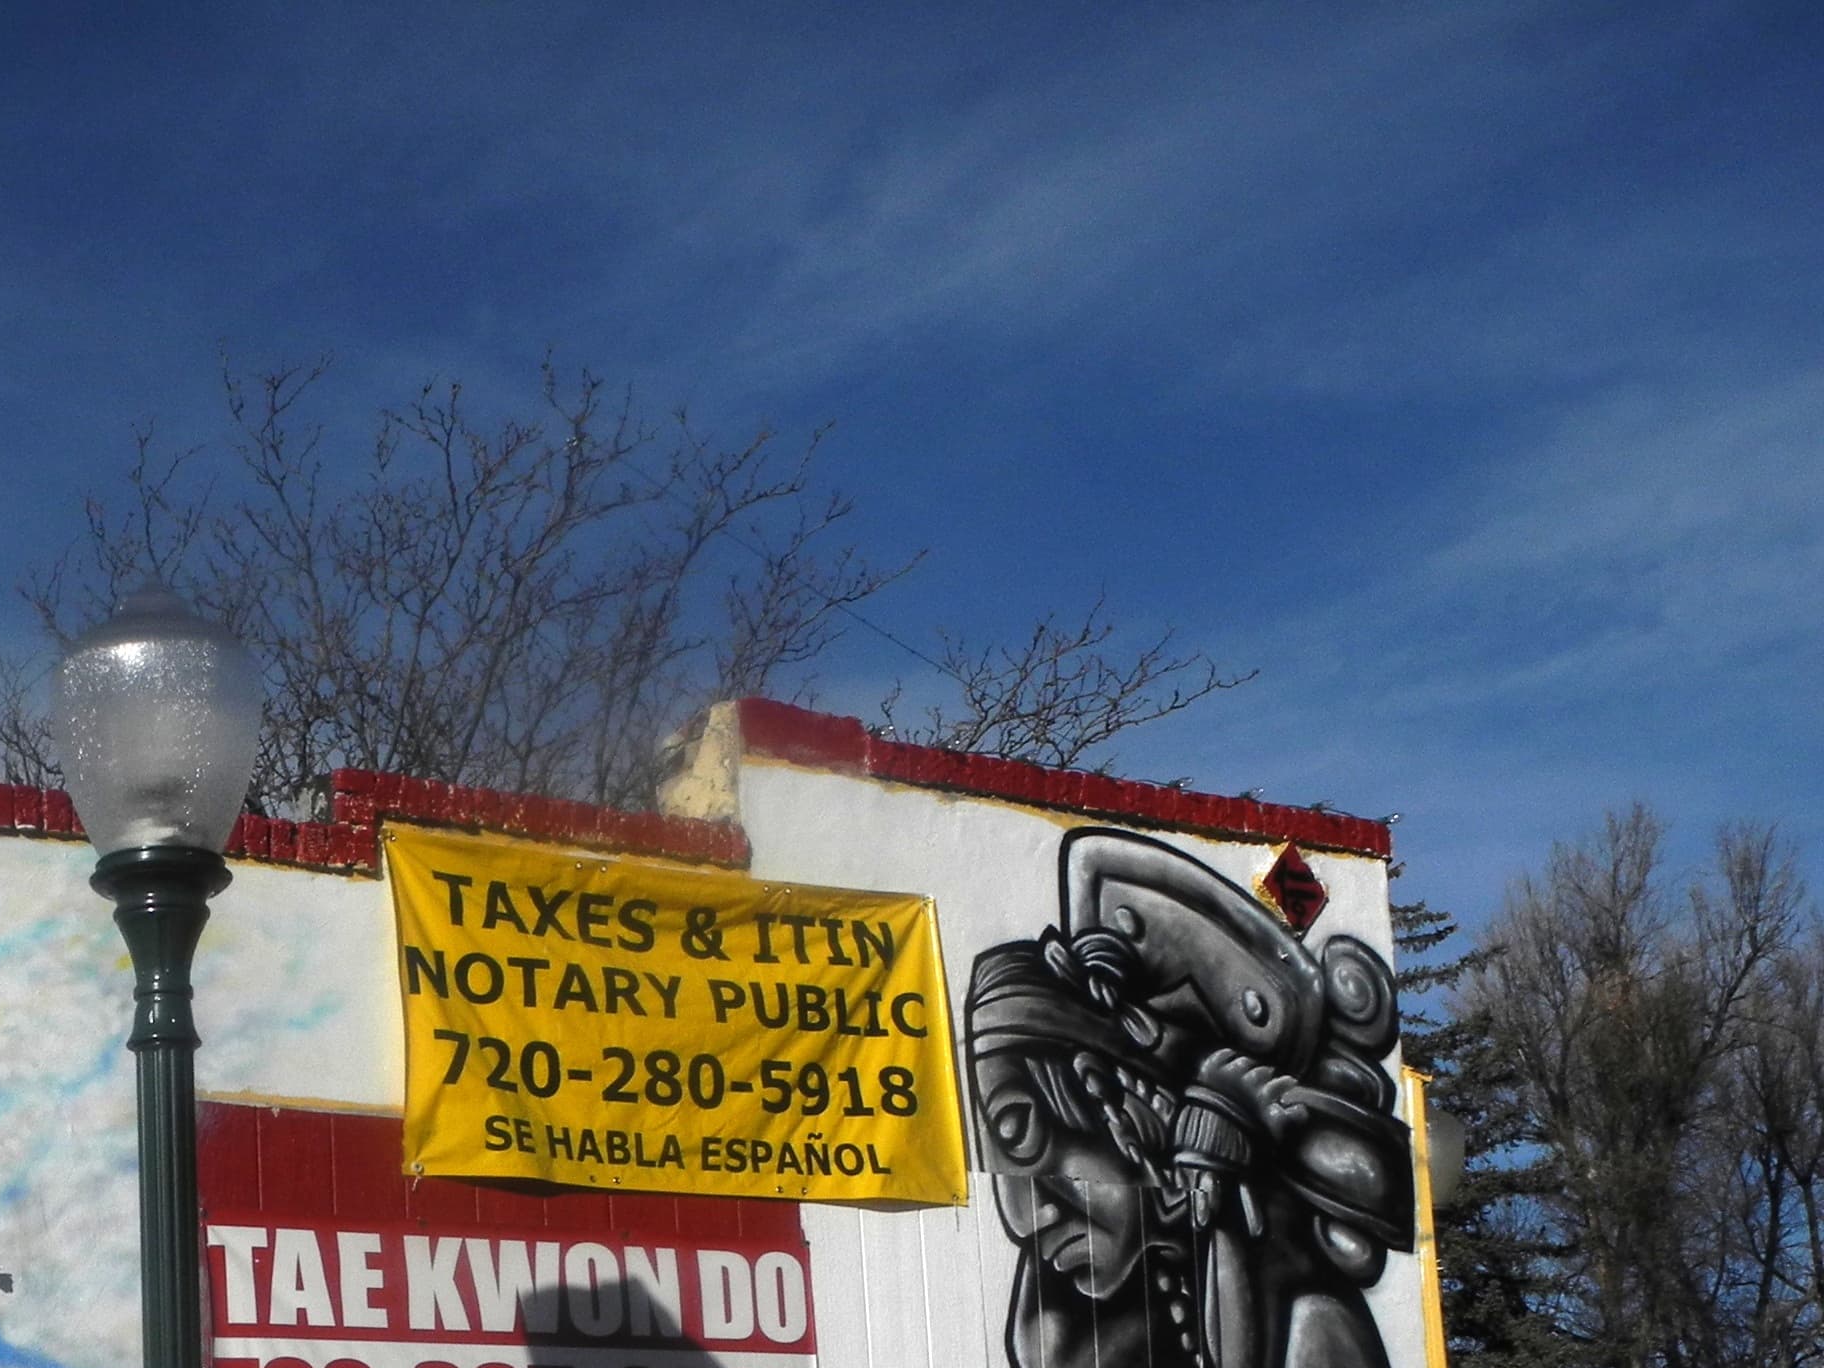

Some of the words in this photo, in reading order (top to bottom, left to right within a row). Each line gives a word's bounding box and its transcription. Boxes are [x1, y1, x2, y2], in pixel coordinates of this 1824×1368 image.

[432, 871, 656, 953] TAXES
[681, 906, 724, 961] &
[753, 912, 895, 970] ITIN
[405, 945, 681, 1019] NOTARY
[709, 979, 928, 1038] PUBLIC
[432, 1030, 918, 1117] 720-280-5918
[485, 1115, 536, 1154] SE
[547, 1126, 685, 1170] HABLA
[701, 1132, 892, 1176] ESPAÑOL
[207, 1225, 389, 1328] TAE
[403, 1235, 683, 1337] KWON
[697, 1249, 808, 1343] DO
